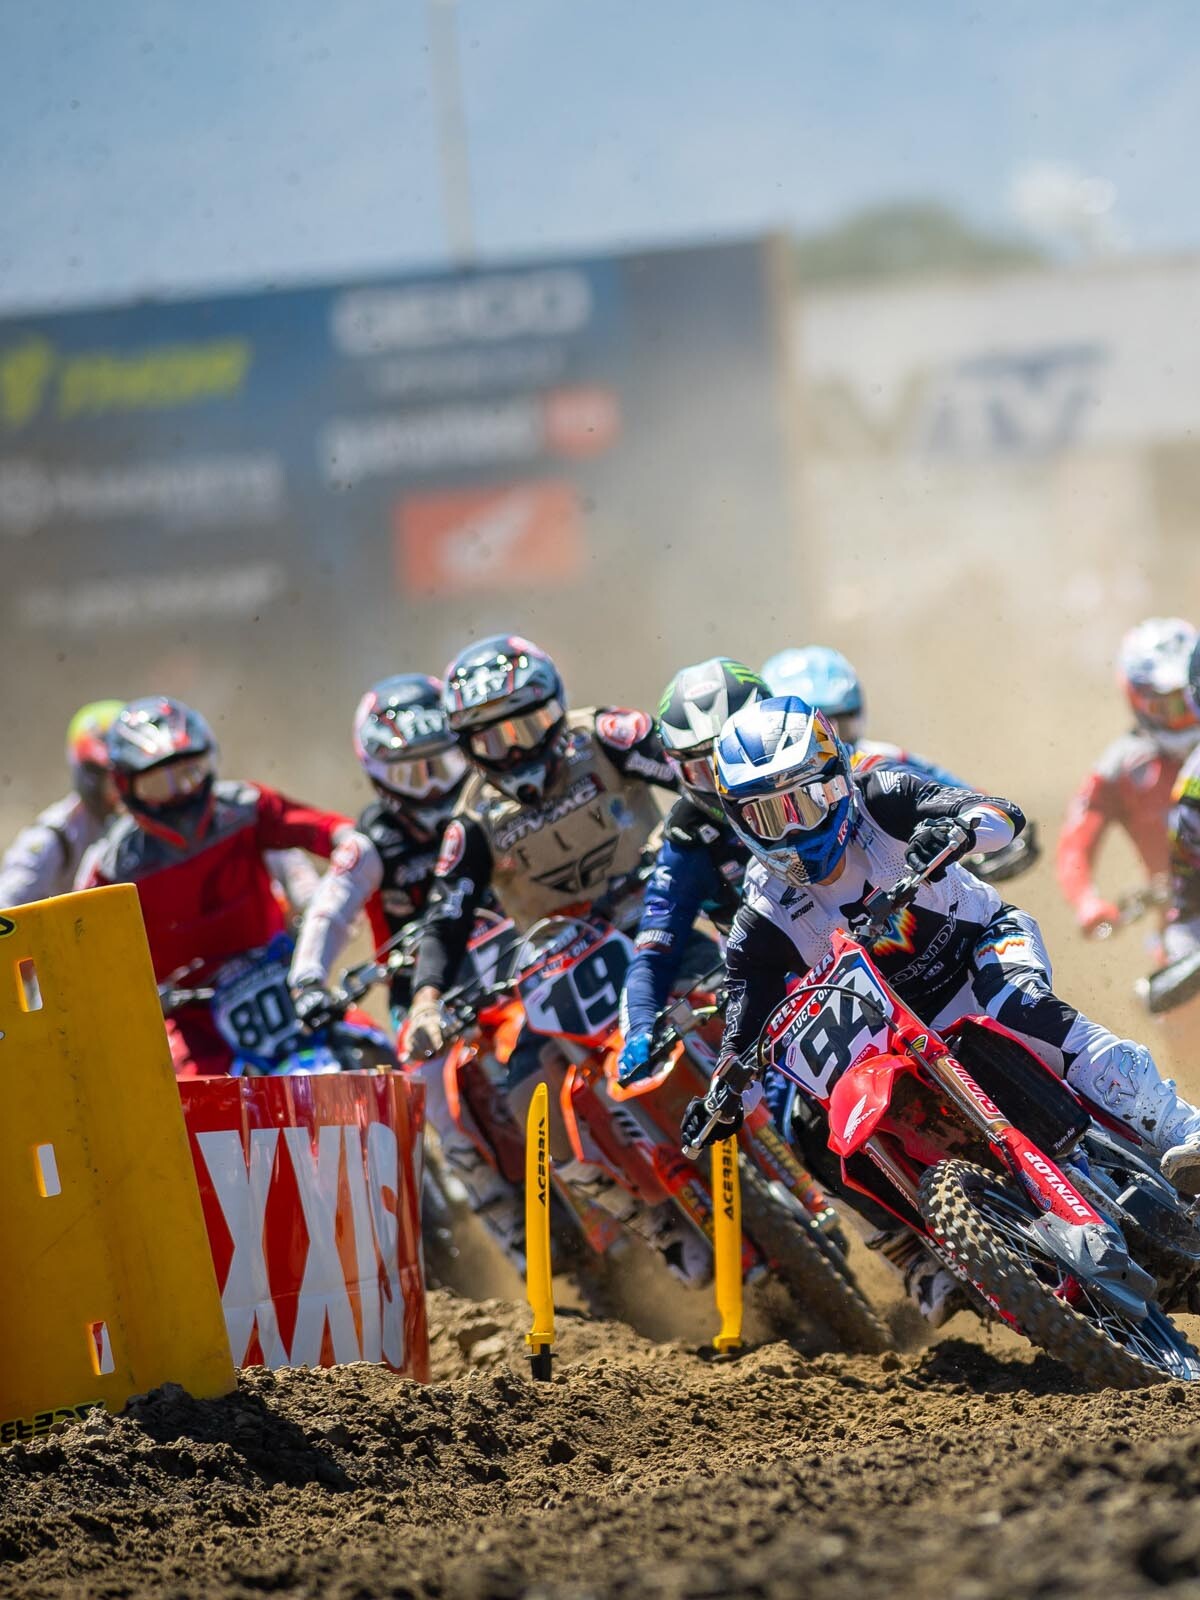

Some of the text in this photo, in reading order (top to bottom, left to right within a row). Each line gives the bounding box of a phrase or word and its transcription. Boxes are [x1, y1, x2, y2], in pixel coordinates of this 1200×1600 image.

[230, 985, 292, 1047] 80
[541, 938, 630, 1035] 19
[800, 975, 888, 1092] 94
[846, 1107, 877, 1144] HONDA
[1022, 1150, 1112, 1218] DUNLOP
[195, 1122, 405, 1370] XXIS
